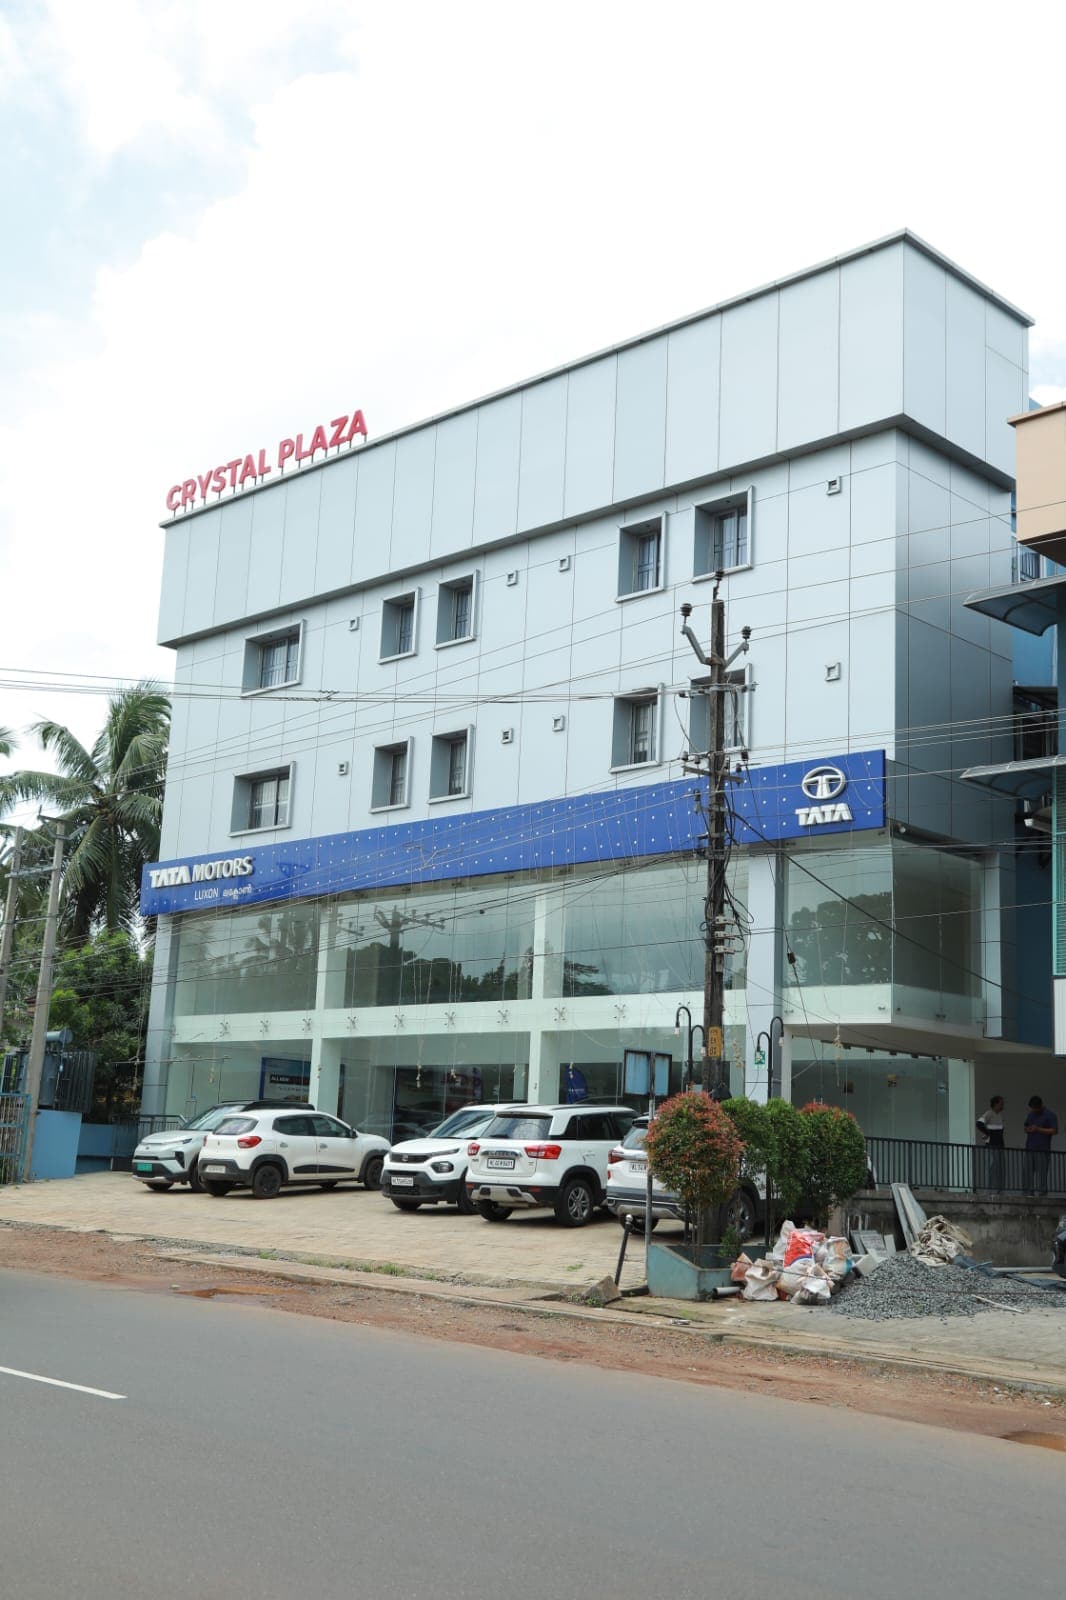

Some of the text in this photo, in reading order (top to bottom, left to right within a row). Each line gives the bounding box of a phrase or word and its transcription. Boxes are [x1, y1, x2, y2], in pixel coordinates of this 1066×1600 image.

[166, 409, 368, 512] CRYSTAL PLAZA
[795, 802, 853, 826] TATA
[149, 856, 254, 889] TATA MOTORS
[194, 888, 219, 900] LUXON
